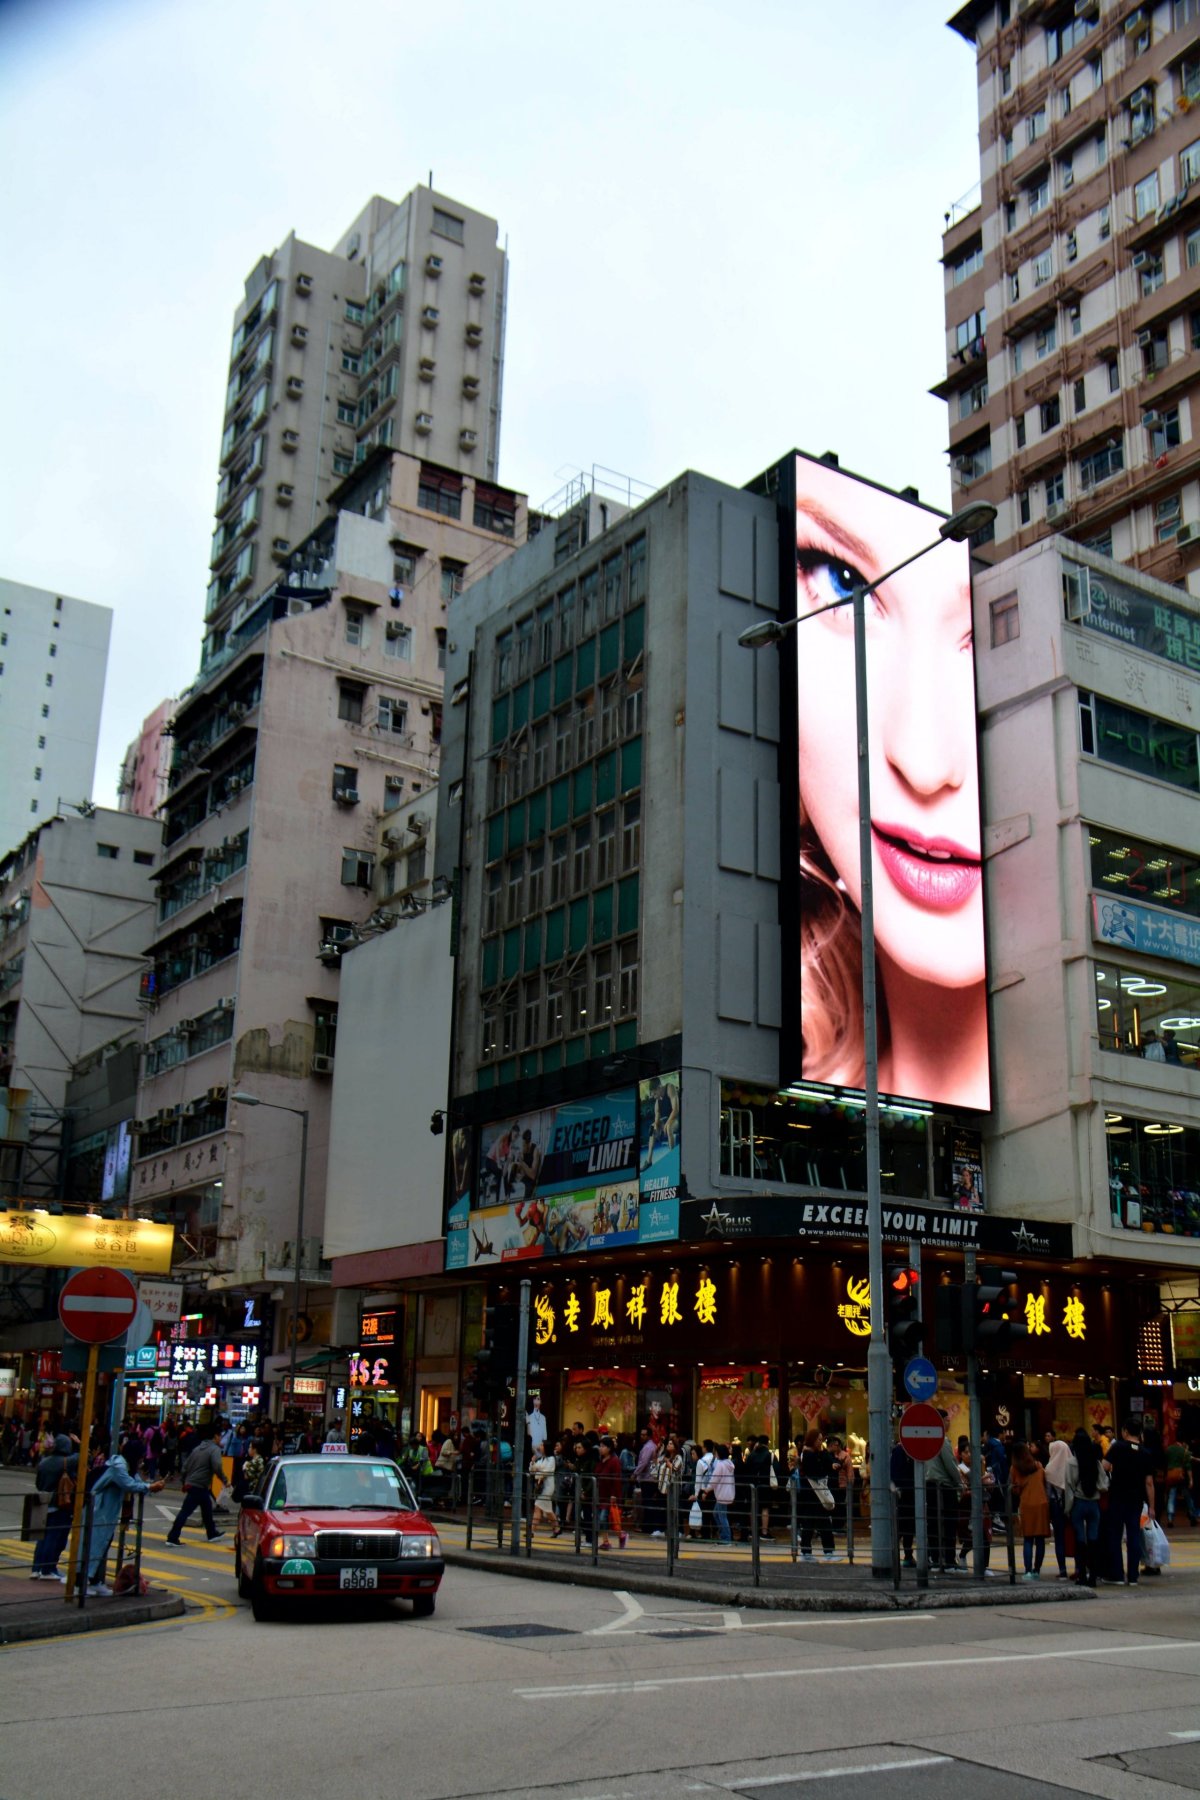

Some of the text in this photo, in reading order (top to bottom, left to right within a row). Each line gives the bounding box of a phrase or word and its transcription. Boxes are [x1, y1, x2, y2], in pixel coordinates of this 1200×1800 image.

[1108, 594, 1130, 616] HRS
[553, 1116, 610, 1151] EXCEED
[572, 1151, 589, 1164] YOUR
[587, 1138, 633, 1173] LIMIT
[644, 1175, 670, 1192] HEALTH
[649, 1187, 677, 1203] FITNESS
[725, 1216, 752, 1225] PLUS
[882, 1210, 927, 1232] YOUR
[933, 1216, 979, 1237] LIMIT
[94, 1237, 137, 1253] 曼谷包
[589, 1235, 606, 1247] DANCE
[1031, 1238, 1050, 1246] PLUS
[351, 1568, 367, 1578] KS
[343, 1577, 374, 1589] 8908
